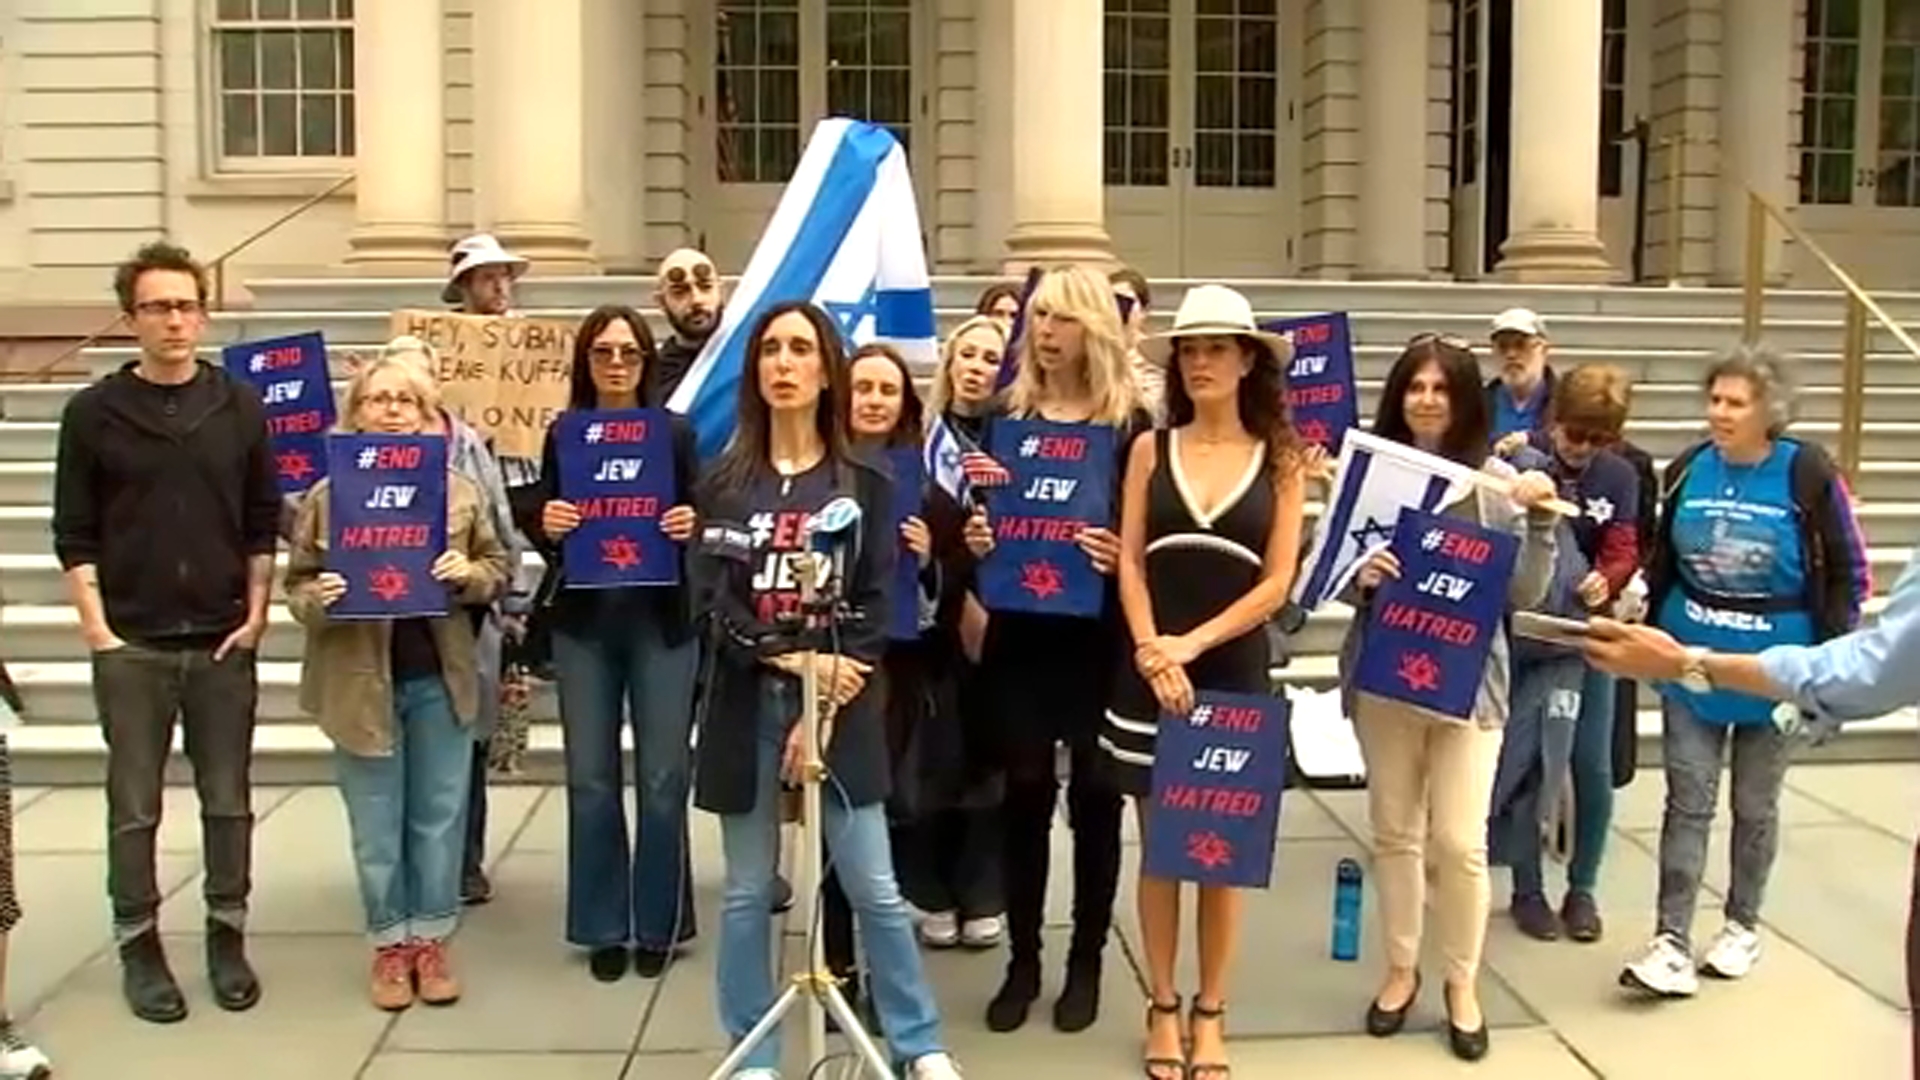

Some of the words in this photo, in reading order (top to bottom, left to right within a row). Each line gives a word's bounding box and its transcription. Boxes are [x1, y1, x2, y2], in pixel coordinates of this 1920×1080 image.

[249, 346, 302, 373] #END
[431, 356, 486, 383] EAVE
[1288, 356, 1328, 377] JEW
[262, 380, 304, 404] JEW
[266, 410, 322, 437] TRED
[459, 405, 553, 428] LONE
[584, 421, 647, 444] #END
[356, 445, 421, 470] #END
[1020, 436, 1087, 459] #END
[594, 458, 644, 481] JEW
[365, 485, 418, 509] JEW
[1024, 477, 1078, 501] JEW
[341, 524, 430, 549] HATRED
[1421, 527, 1491, 565] #END
[1416, 571, 1475, 601] JEW
[1382, 602, 1478, 647] HATRED
[1189, 704, 1262, 733] #END
[1193, 746, 1252, 773] JEW
[1162, 784, 1261, 817] HATRED
